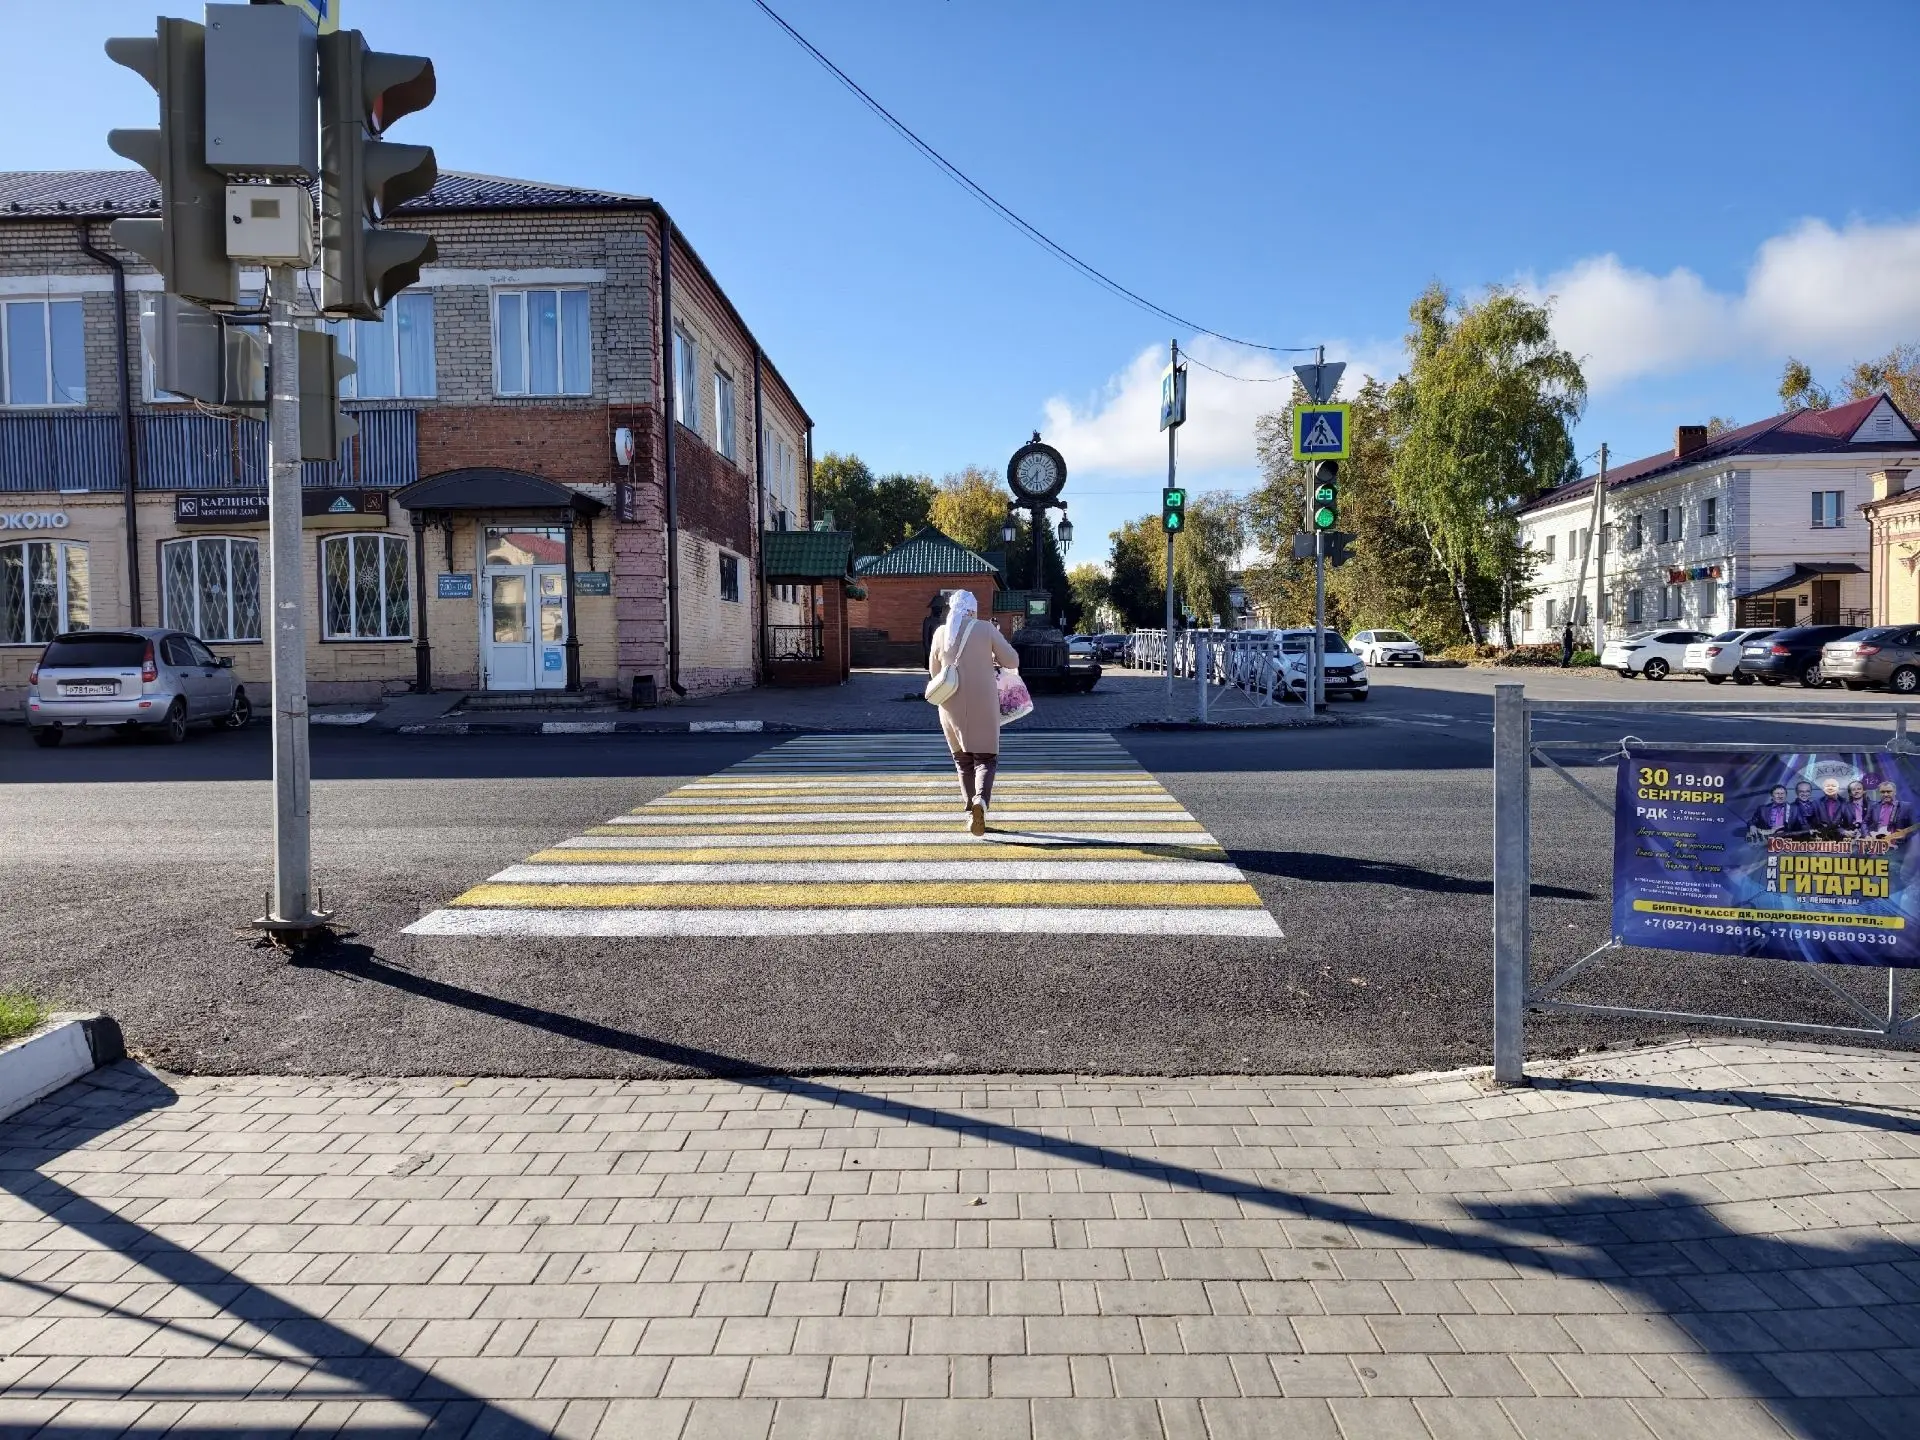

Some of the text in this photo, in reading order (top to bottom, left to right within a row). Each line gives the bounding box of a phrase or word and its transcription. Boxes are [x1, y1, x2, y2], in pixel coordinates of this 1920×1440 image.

[1167, 492, 1181, 506] 29
[1318, 488, 1333, 500] 29
[200, 508, 258, 516] МЯСНОЙ ДОМ
[1639, 767, 1725, 788] 30 19:00
[1637, 788, 1725, 804] СЕНТЯБРЯ
[1636, 806, 1668, 820] РДК
[1857, 838, 1890, 855] ТУР
[1766, 855, 1778, 892] ВИА
[1779, 856, 1889, 877] ПОЮЩИЕ
[1779, 873, 1889, 898] ГИТАРЫ
[1796, 896, 1860, 905] ИЗ ЛЕНИНГРАДА!
[1652, 903, 1693, 914] БИЛЕТЫ
[1704, 909, 1735, 918] КАССЕ
[1738, 911, 1754, 919] ДК,
[1756, 911, 1835, 923] ПОДРОБНОСТИ
[1837, 915, 1853, 923] ПО
[1856, 917, 1884, 926] ТЕЛ.:
[1770, 928, 1897, 945] +7(919)6809330
